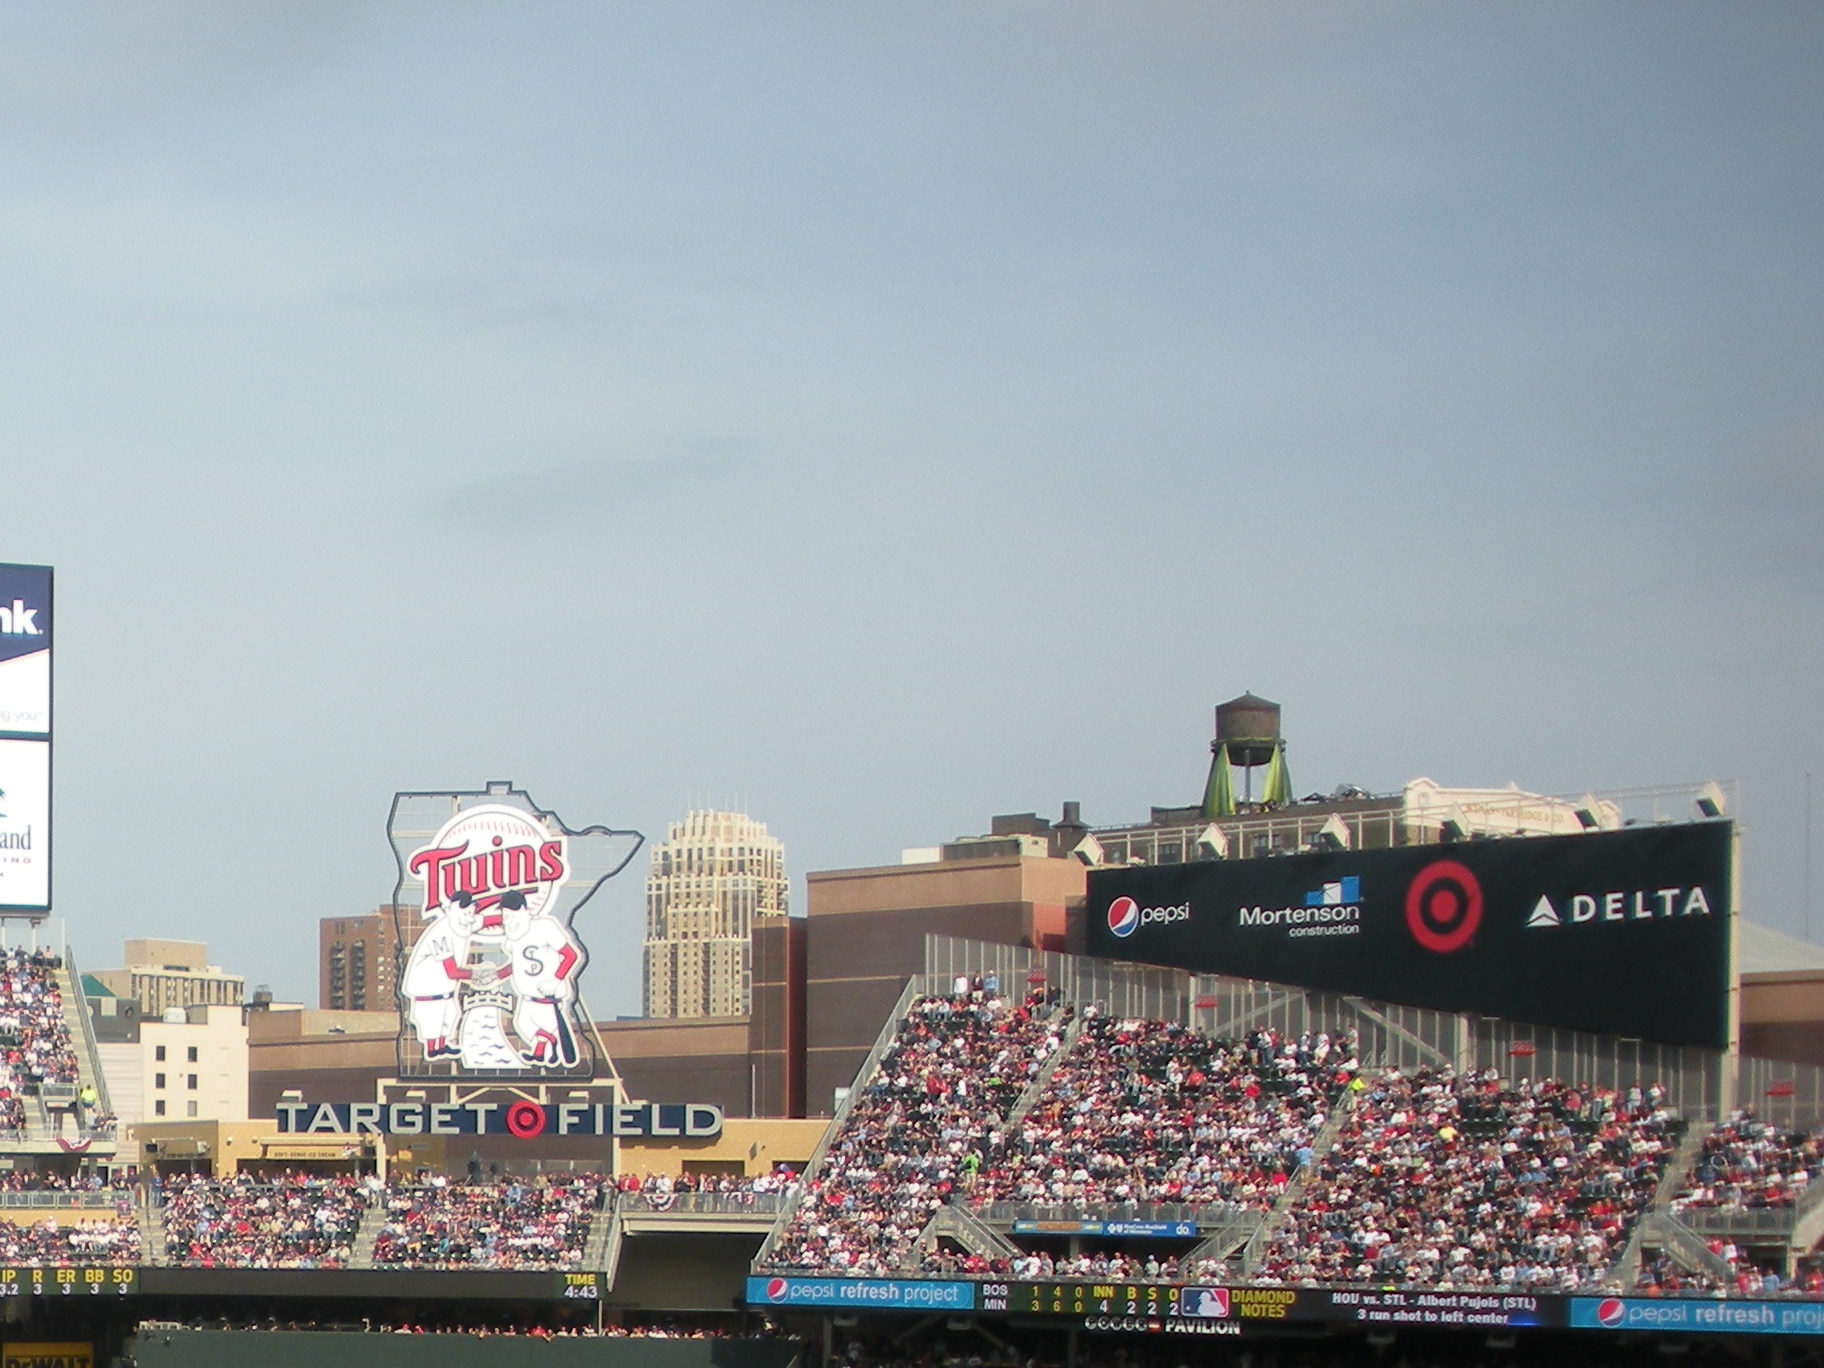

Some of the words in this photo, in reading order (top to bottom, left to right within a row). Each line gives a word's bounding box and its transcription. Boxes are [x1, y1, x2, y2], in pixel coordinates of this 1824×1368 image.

[410, 836, 565, 911] Twins
[1572, 886, 1708, 922] DELTA
[1140, 902, 1190, 926] pepsi
[1239, 906, 1359, 926] Mortenson
[1289, 924, 1358, 937] construction
[277, 1103, 498, 1134] TARGET
[559, 1104, 723, 1136] FIELD
[565, 1274, 595, 1285] TIME
[564, 1286, 597, 1298] 4:43
[791, 1283, 834, 1300] pepsi
[840, 1282, 898, 1299] refresh
[904, 1284, 958, 1304] project
[983, 1285, 1008, 1296] BOS
[1232, 1291, 1295, 1304] DIAMOND
[984, 1298, 1006, 1310] MIN
[1332, 1292, 1359, 1304] HOU
[1363, 1296, 1380, 1304] vs.
[1384, 1293, 1406, 1305] STL
[1417, 1295, 1457, 1307] Albert
[1460, 1296, 1499, 1309] Pujols
[1503, 1296, 1537, 1310] (STL)
[1241, 1305, 1285, 1317] NOTES
[1357, 1309, 1366, 1320] 3
[1370, 1312, 1388, 1321] run
[1392, 1310, 1420, 1321] shot
[1425, 1312, 1437, 1322] to
[1441, 1311, 1463, 1323] left
[1467, 1314, 1508, 1324] center
[1630, 1306, 1687, 1324] pepsi
[1696, 1305, 1774, 1324] refresh
[1165, 1320, 1240, 1335] PAVILION
